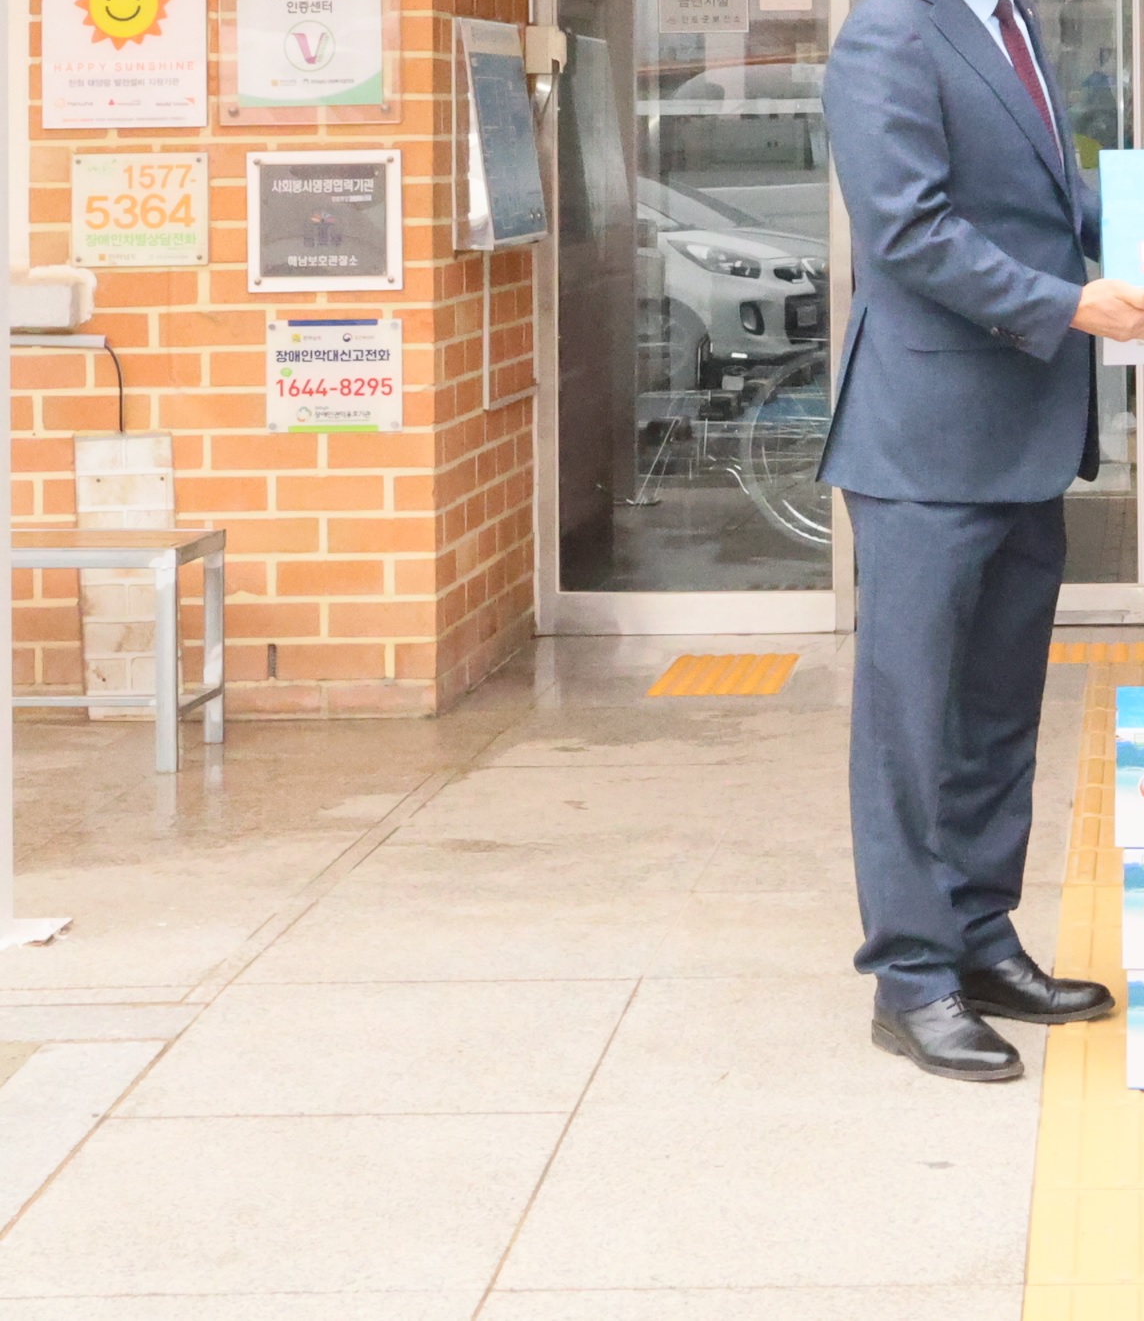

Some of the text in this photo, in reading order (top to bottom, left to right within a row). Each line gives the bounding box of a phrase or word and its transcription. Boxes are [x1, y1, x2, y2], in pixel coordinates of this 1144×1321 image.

[286, 1, 333, 14] 인증센터
[54, 61, 195, 72] HAPPY SUNSHINE
[272, 179, 374, 193] 사회봉사명령협력기관
[84, 193, 196, 230] 5364
[86, 232, 197, 248] 장애인차별상담전화
[287, 255, 358, 267] 해남보호관찰소
[276, 349, 390, 363] 장애인학대신고전화
[276, 378, 393, 397] 1644-8295
